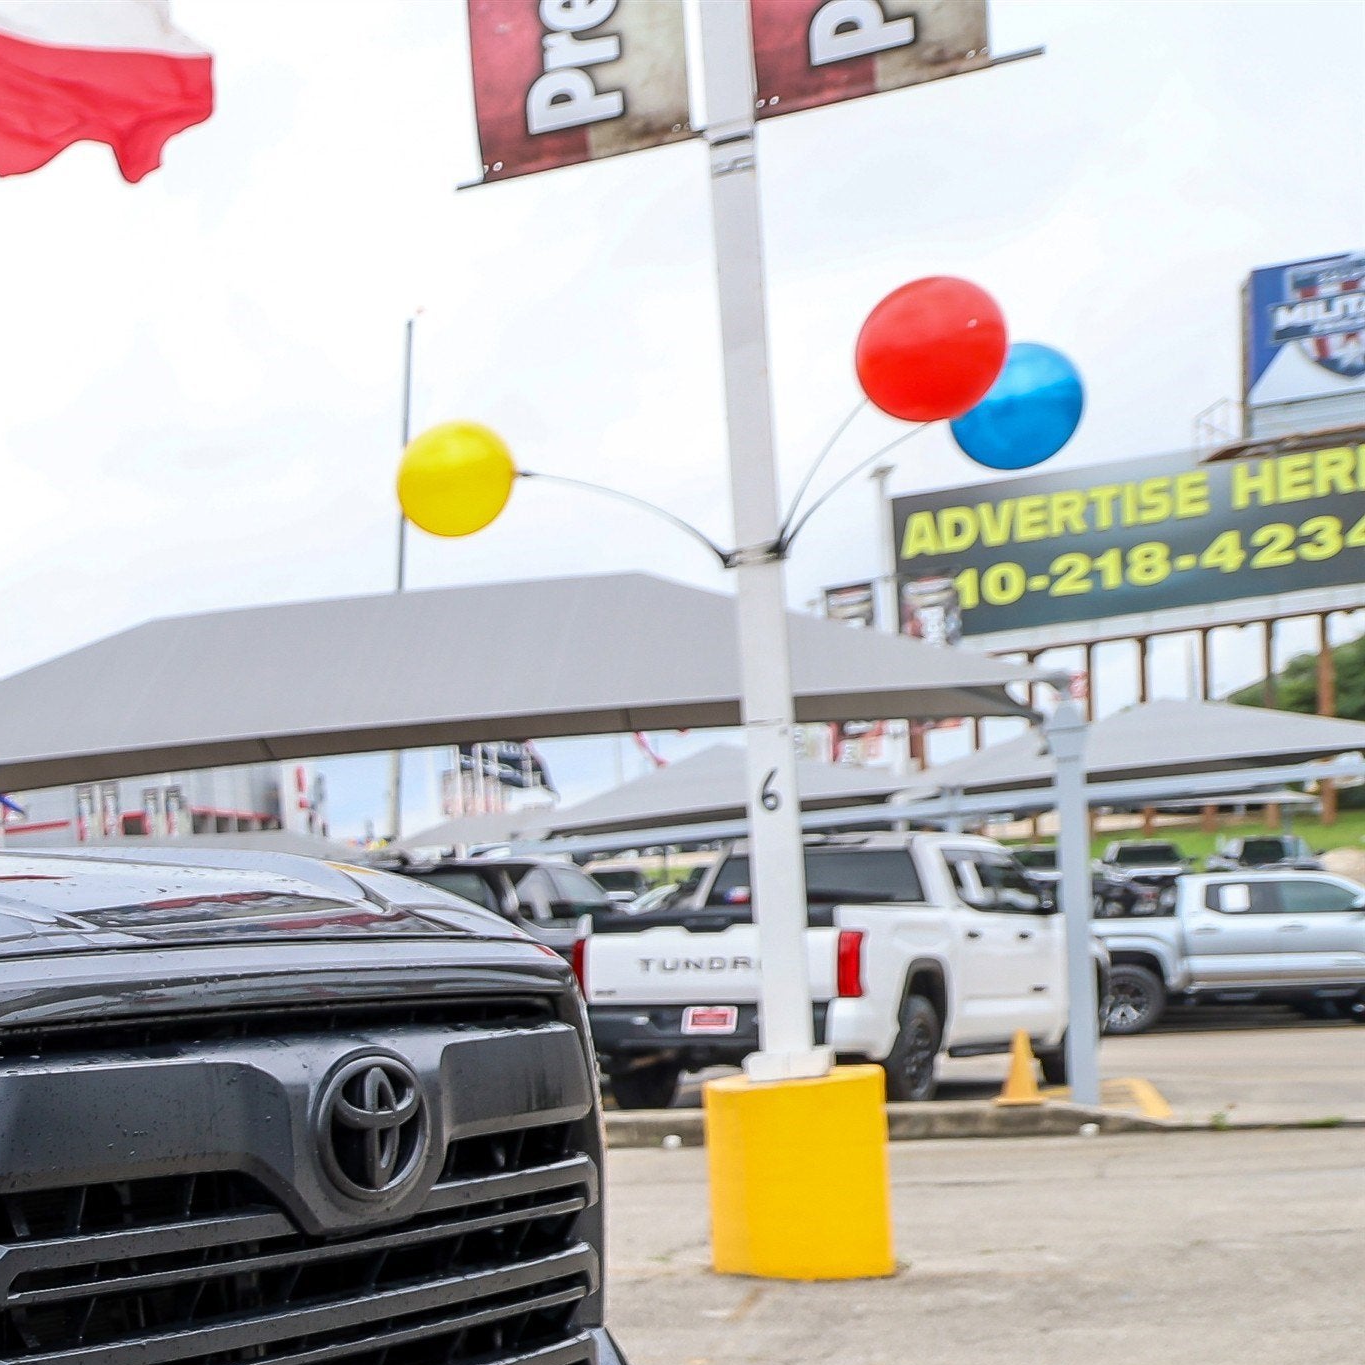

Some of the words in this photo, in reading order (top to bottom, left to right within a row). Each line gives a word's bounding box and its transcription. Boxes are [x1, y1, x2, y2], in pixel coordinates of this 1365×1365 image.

[900, 470, 1211, 559] ADVERTISE
[1230, 443, 1365, 511] HER
[762, 767, 781, 811] 6
[639, 956, 764, 973] TUNDR
